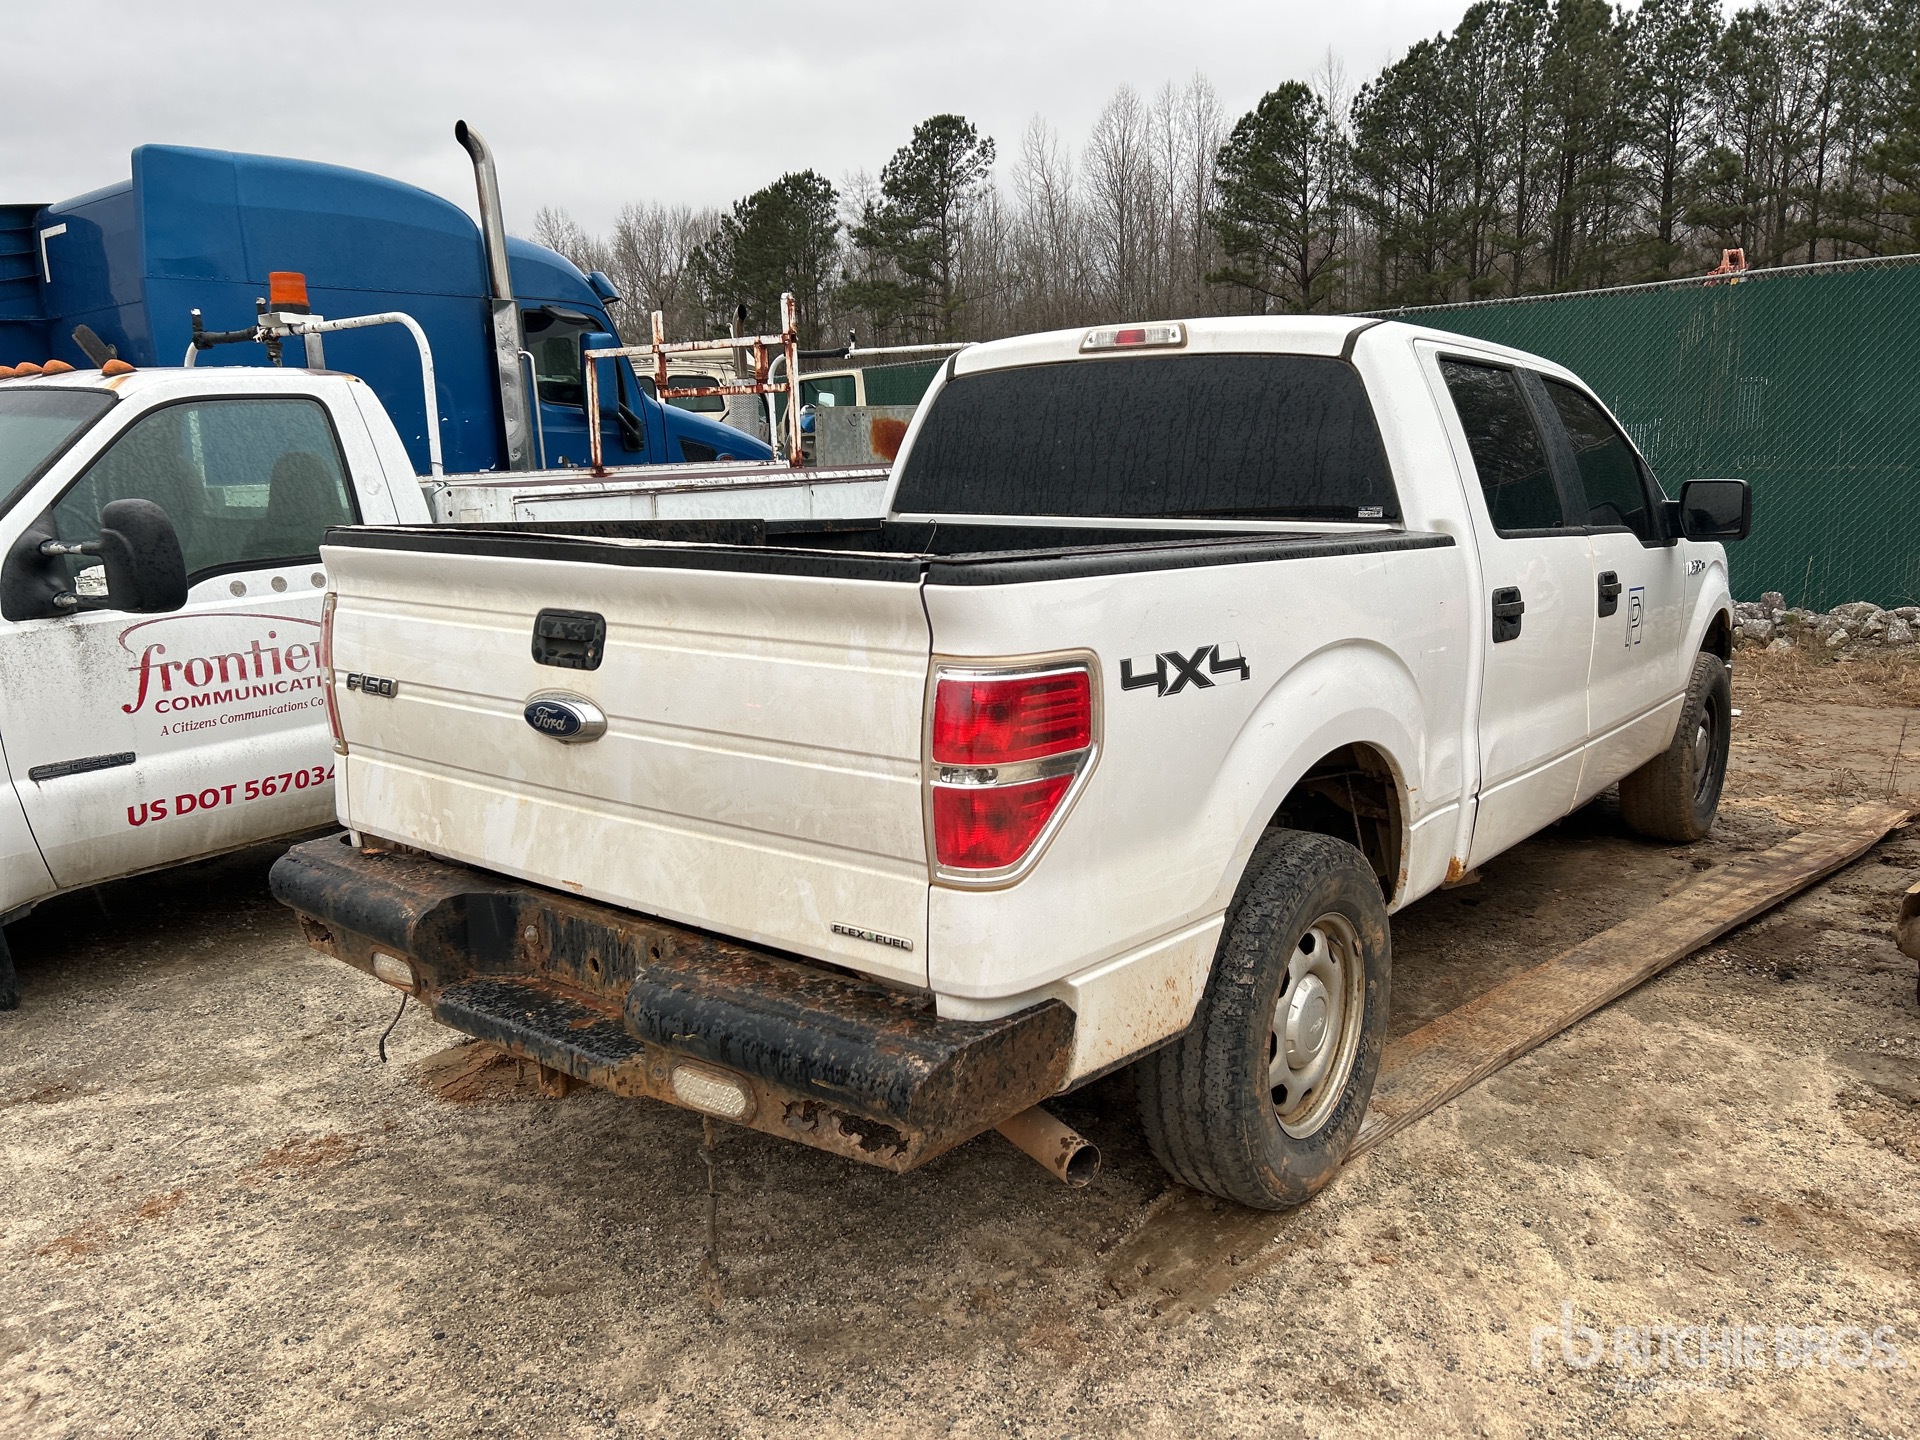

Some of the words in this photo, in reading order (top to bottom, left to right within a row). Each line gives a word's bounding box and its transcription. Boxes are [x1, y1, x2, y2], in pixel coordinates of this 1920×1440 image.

[346, 672, 397, 697] F-150
[160, 725, 170, 737] A
[172, 716, 218, 735] Citizens
[220, 700, 309, 725] Communications
[533, 706, 567, 731] Ford
[127, 799, 168, 827] US
[175, 784, 237, 817] DOT
[833, 924, 865, 940] FLEX
[875, 934, 909, 950] FUEL
